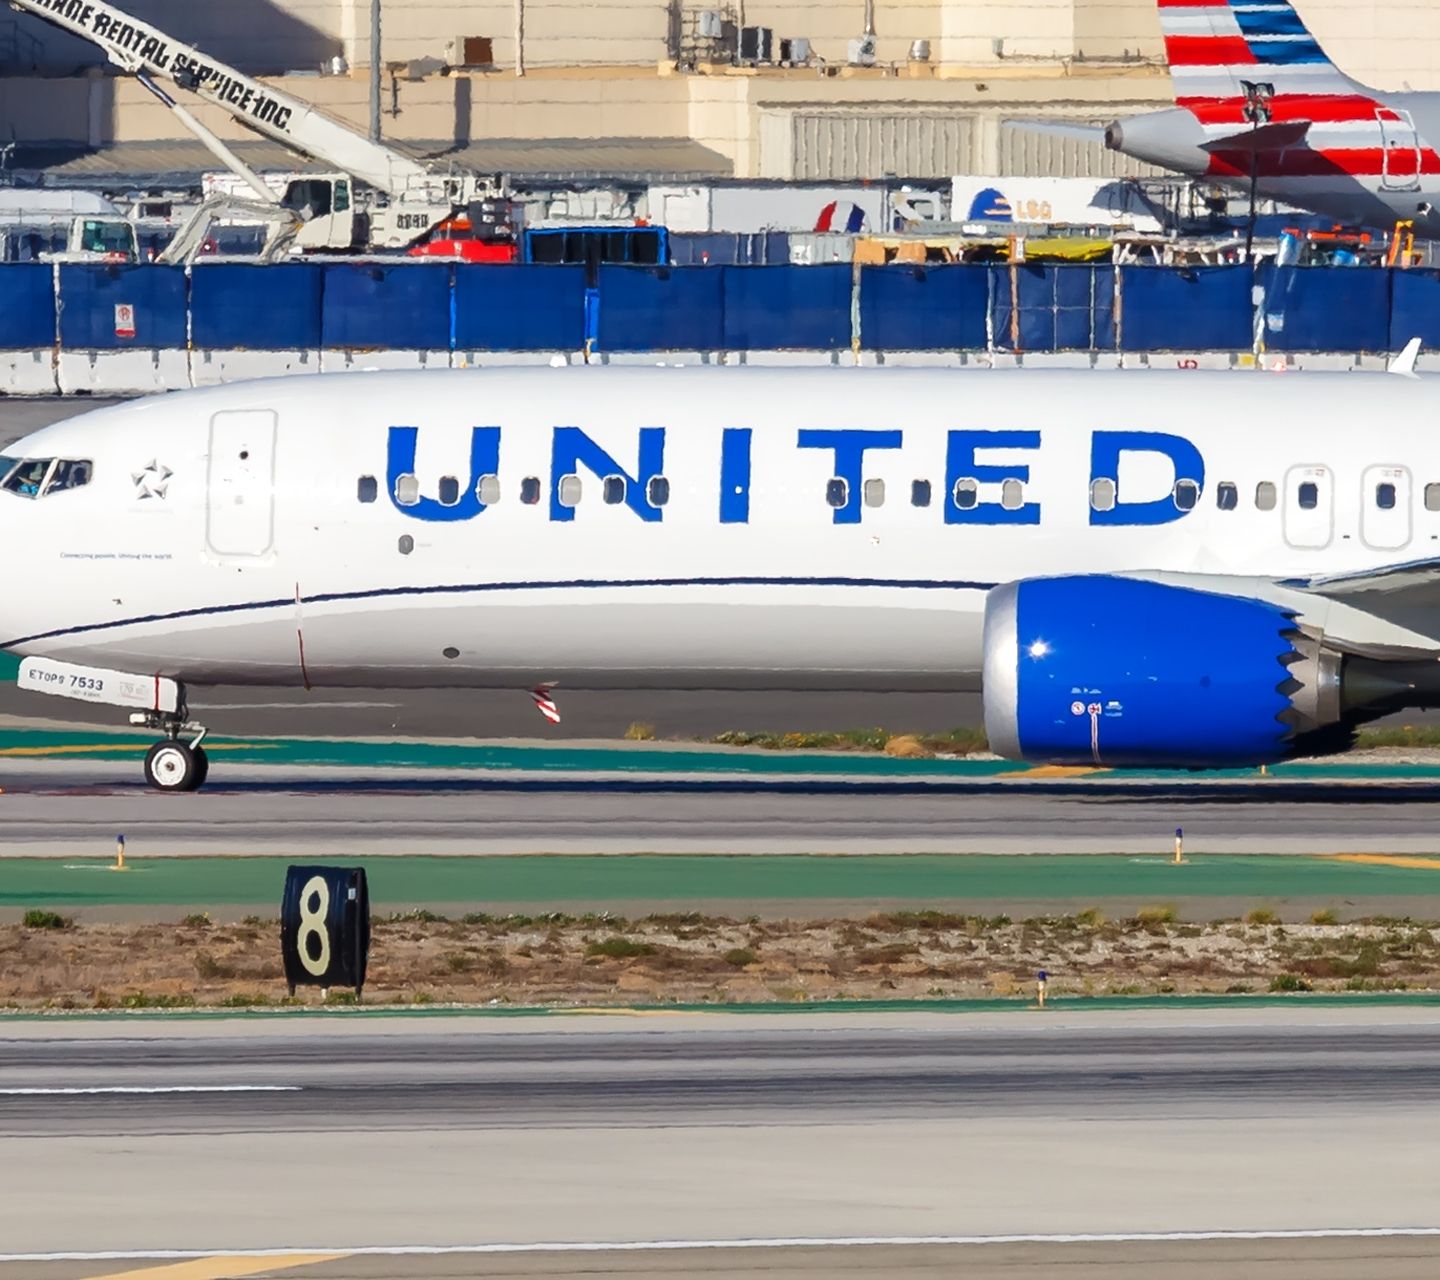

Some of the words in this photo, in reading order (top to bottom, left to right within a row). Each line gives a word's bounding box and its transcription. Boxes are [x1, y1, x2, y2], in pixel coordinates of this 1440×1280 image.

[91, 10, 170, 69] RENTAL
[386, 425, 1206, 527] UNITED
[28, 668, 65, 685] ETOPS
[69, 674, 104, 691] 7533
[298, 875, 331, 977] 8
